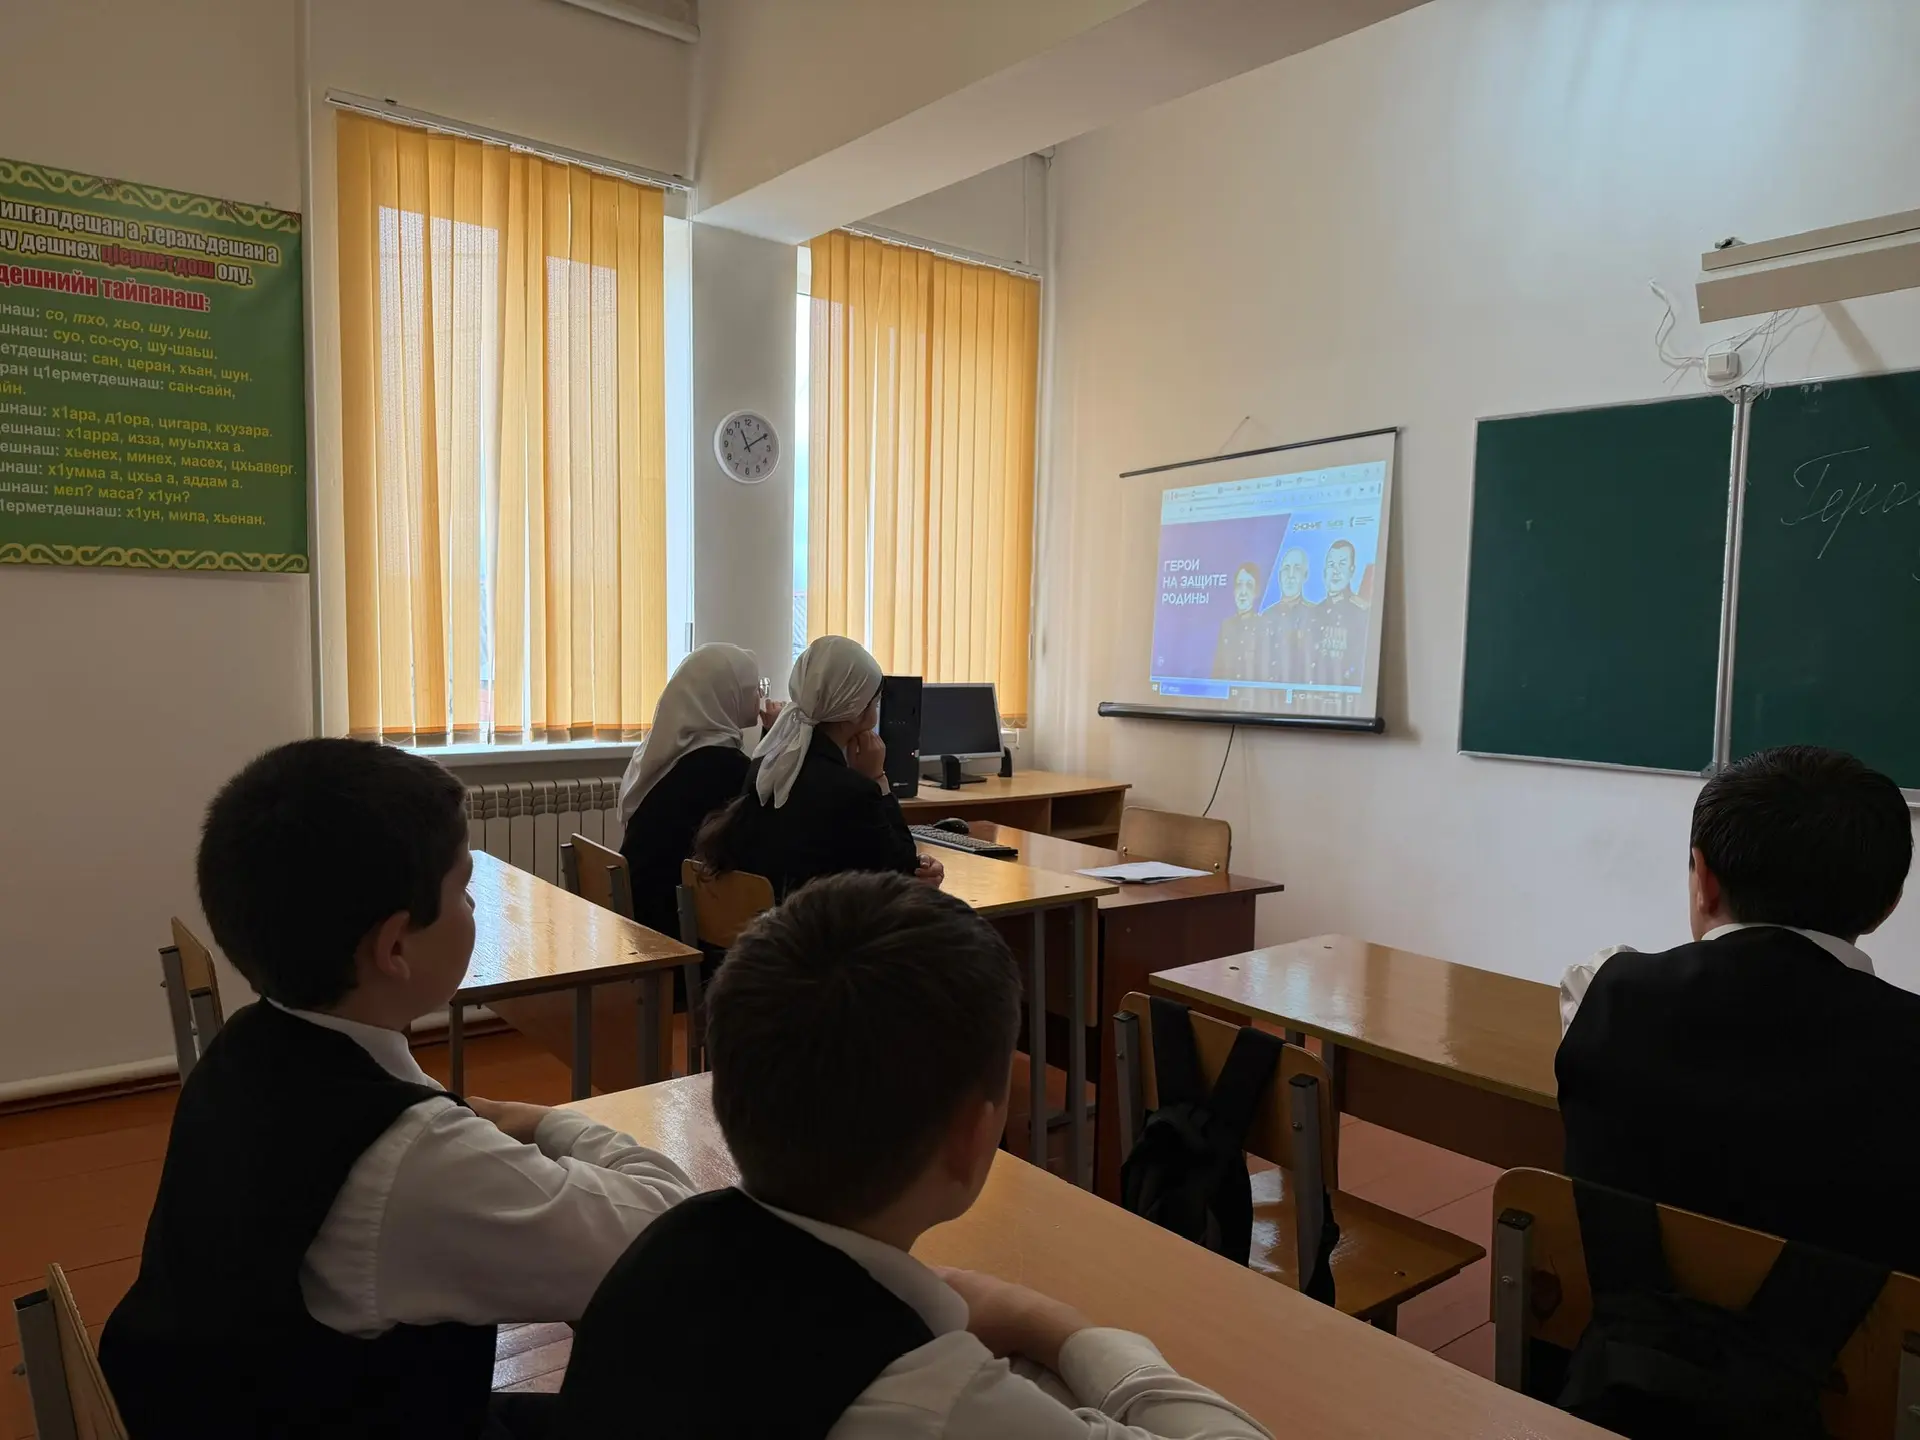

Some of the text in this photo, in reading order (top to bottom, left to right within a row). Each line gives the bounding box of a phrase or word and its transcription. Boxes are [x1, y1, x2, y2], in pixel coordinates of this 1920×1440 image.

[0, 201, 125, 239] илгалдешан
[127, 222, 139, 241] а
[267, 246, 278, 263] а
[20, 231, 99, 261] дешнех
[217, 263, 253, 286] олу.
[0, 264, 211, 312] дешнийн тайпанаш:
[0, 304, 40, 318] наш:
[45, 309, 68, 324] со,
[149, 323, 174, 337] шу,
[178, 327, 211, 340] уьш.
[53, 330, 85, 344] суо,
[89, 334, 143, 353] со-суо,
[147, 341, 218, 360] шу-шаьш.
[1, 342, 253, 382] етдешнаш: сан, церан, хьан, шун.
[0, 381, 26, 395] йн.
[168, 381, 236, 399] сан-сайн,
[158, 417, 212, 434] цигара,
[215, 424, 273, 438] кхузара.
[726, 428, 734, 436] 10
[734, 421, 740, 429] 11
[744, 418, 752, 427] 12
[0, 422, 61, 437] ешнаш:
[128, 433, 164, 448] изза,
[168, 437, 229, 451] муьлхха
[233, 443, 245, 452] а.
[0, 442, 297, 476] ешнаш: хьенех, минех, масех, цхьаверг.
[110, 470, 123, 481] а,
[127, 471, 162, 484] цхьа
[166, 474, 179, 486] а,
[183, 475, 228, 488] аддам
[231, 479, 243, 489] а.
[54, 485, 94, 497] мел?
[98, 488, 144, 500] маса?
[1781, 446, 1920, 559] Геро
[168, 510, 210, 524] мила,
[213, 513, 266, 525] хьенан.
[1164, 559, 1200, 573] ГЕРОИ
[1162, 574, 1228, 590] НА ЗАЩИТЕ
[1162, 592, 1210, 606] РОДИНЫ
